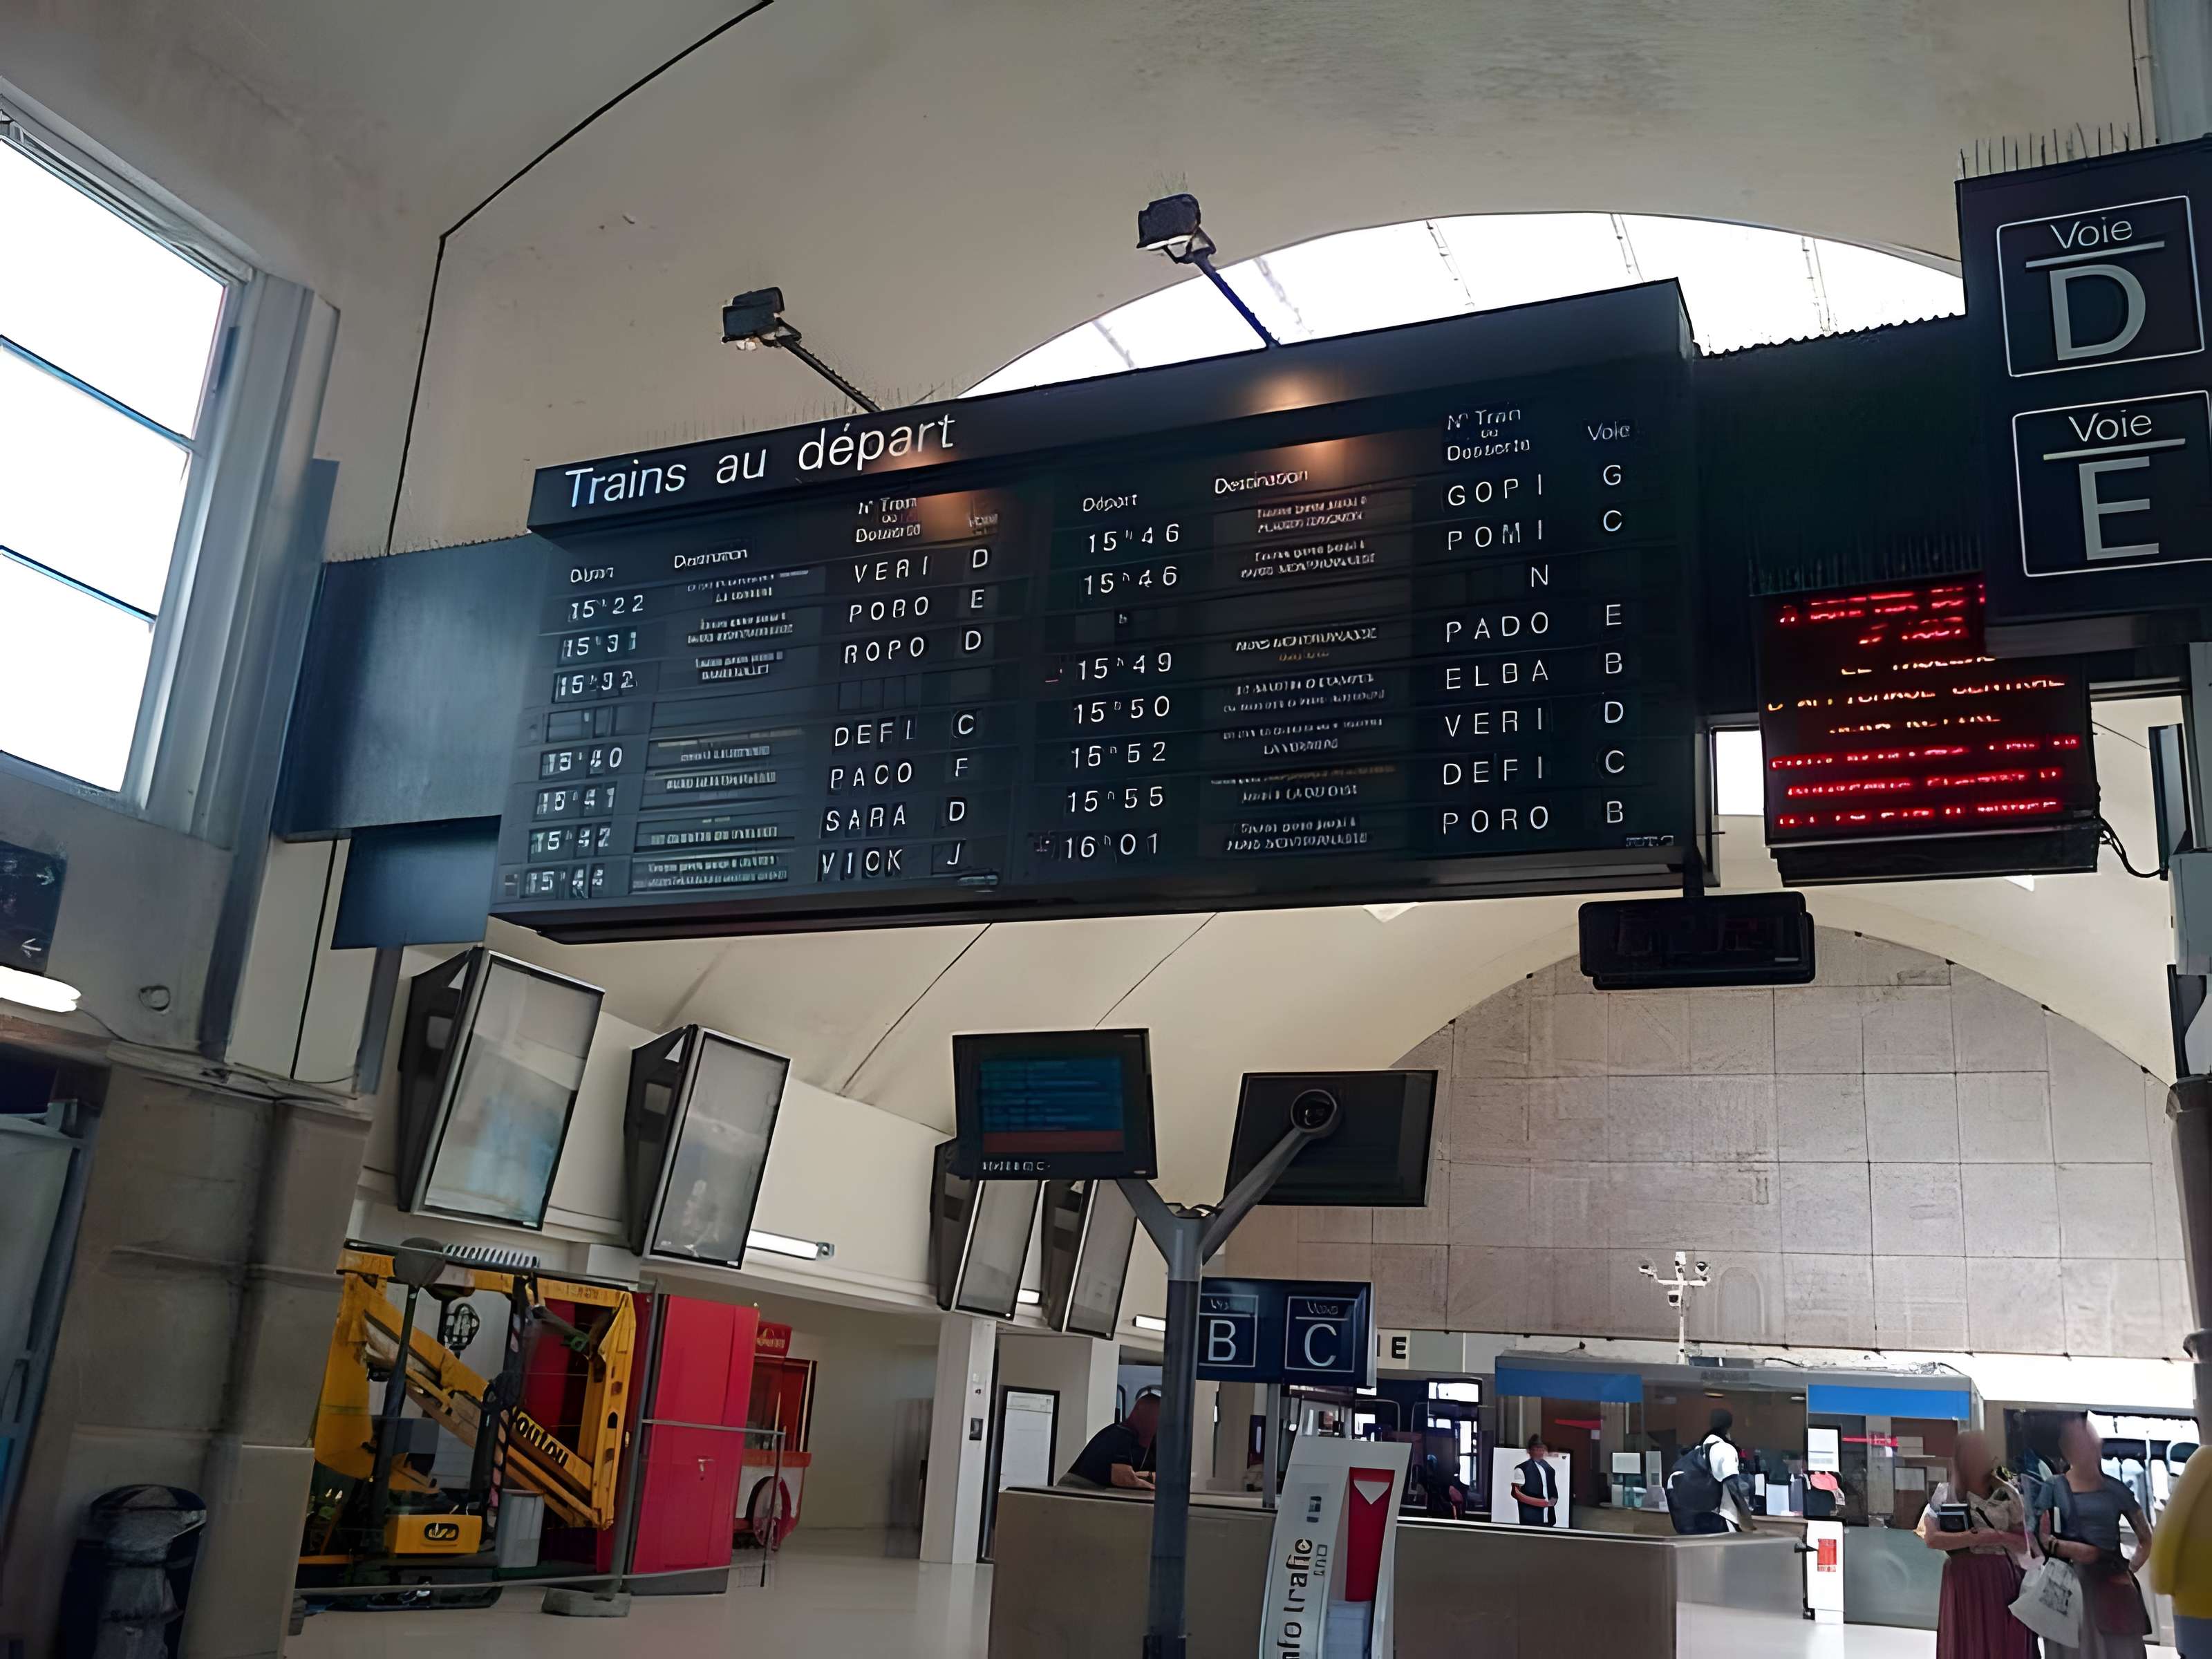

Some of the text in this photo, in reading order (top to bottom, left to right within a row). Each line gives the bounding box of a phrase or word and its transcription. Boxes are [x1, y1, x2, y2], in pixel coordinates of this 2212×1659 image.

[2050, 217, 2133, 250] Voie
[2050, 264, 2146, 361] D
[2068, 410, 2152, 442] Voie
[565, 413, 956, 507] Trains au départ
[1447, 474, 1542, 506] GOPI
[1603, 465, 1622, 485] G
[2079, 456, 2159, 561] E
[1448, 519, 1542, 550] POMI
[1602, 509, 1622, 532] C
[973, 549, 988, 568] D
[1531, 564, 1548, 588] N
[971, 589, 984, 608] E
[965, 630, 982, 650] D
[1446, 611, 1548, 643] PADO
[1606, 603, 1622, 626] E
[1446, 659, 1548, 689] ELBA
[1605, 653, 1622, 674] B
[834, 720, 912, 747] DEFI
[958, 714, 975, 735] C
[1445, 707, 1542, 737] VERI
[1604, 701, 1624, 724] D
[955, 758, 968, 778] F
[1443, 756, 1542, 785] DEFI
[1605, 750, 1624, 774] C
[826, 804, 906, 832] SARA
[948, 801, 965, 822] D
[1443, 806, 1548, 835] PORO
[1606, 800, 1624, 823] B
[946, 843, 961, 865] J
[1208, 1320, 1237, 1362] B
[1304, 1323, 1338, 1367] C
